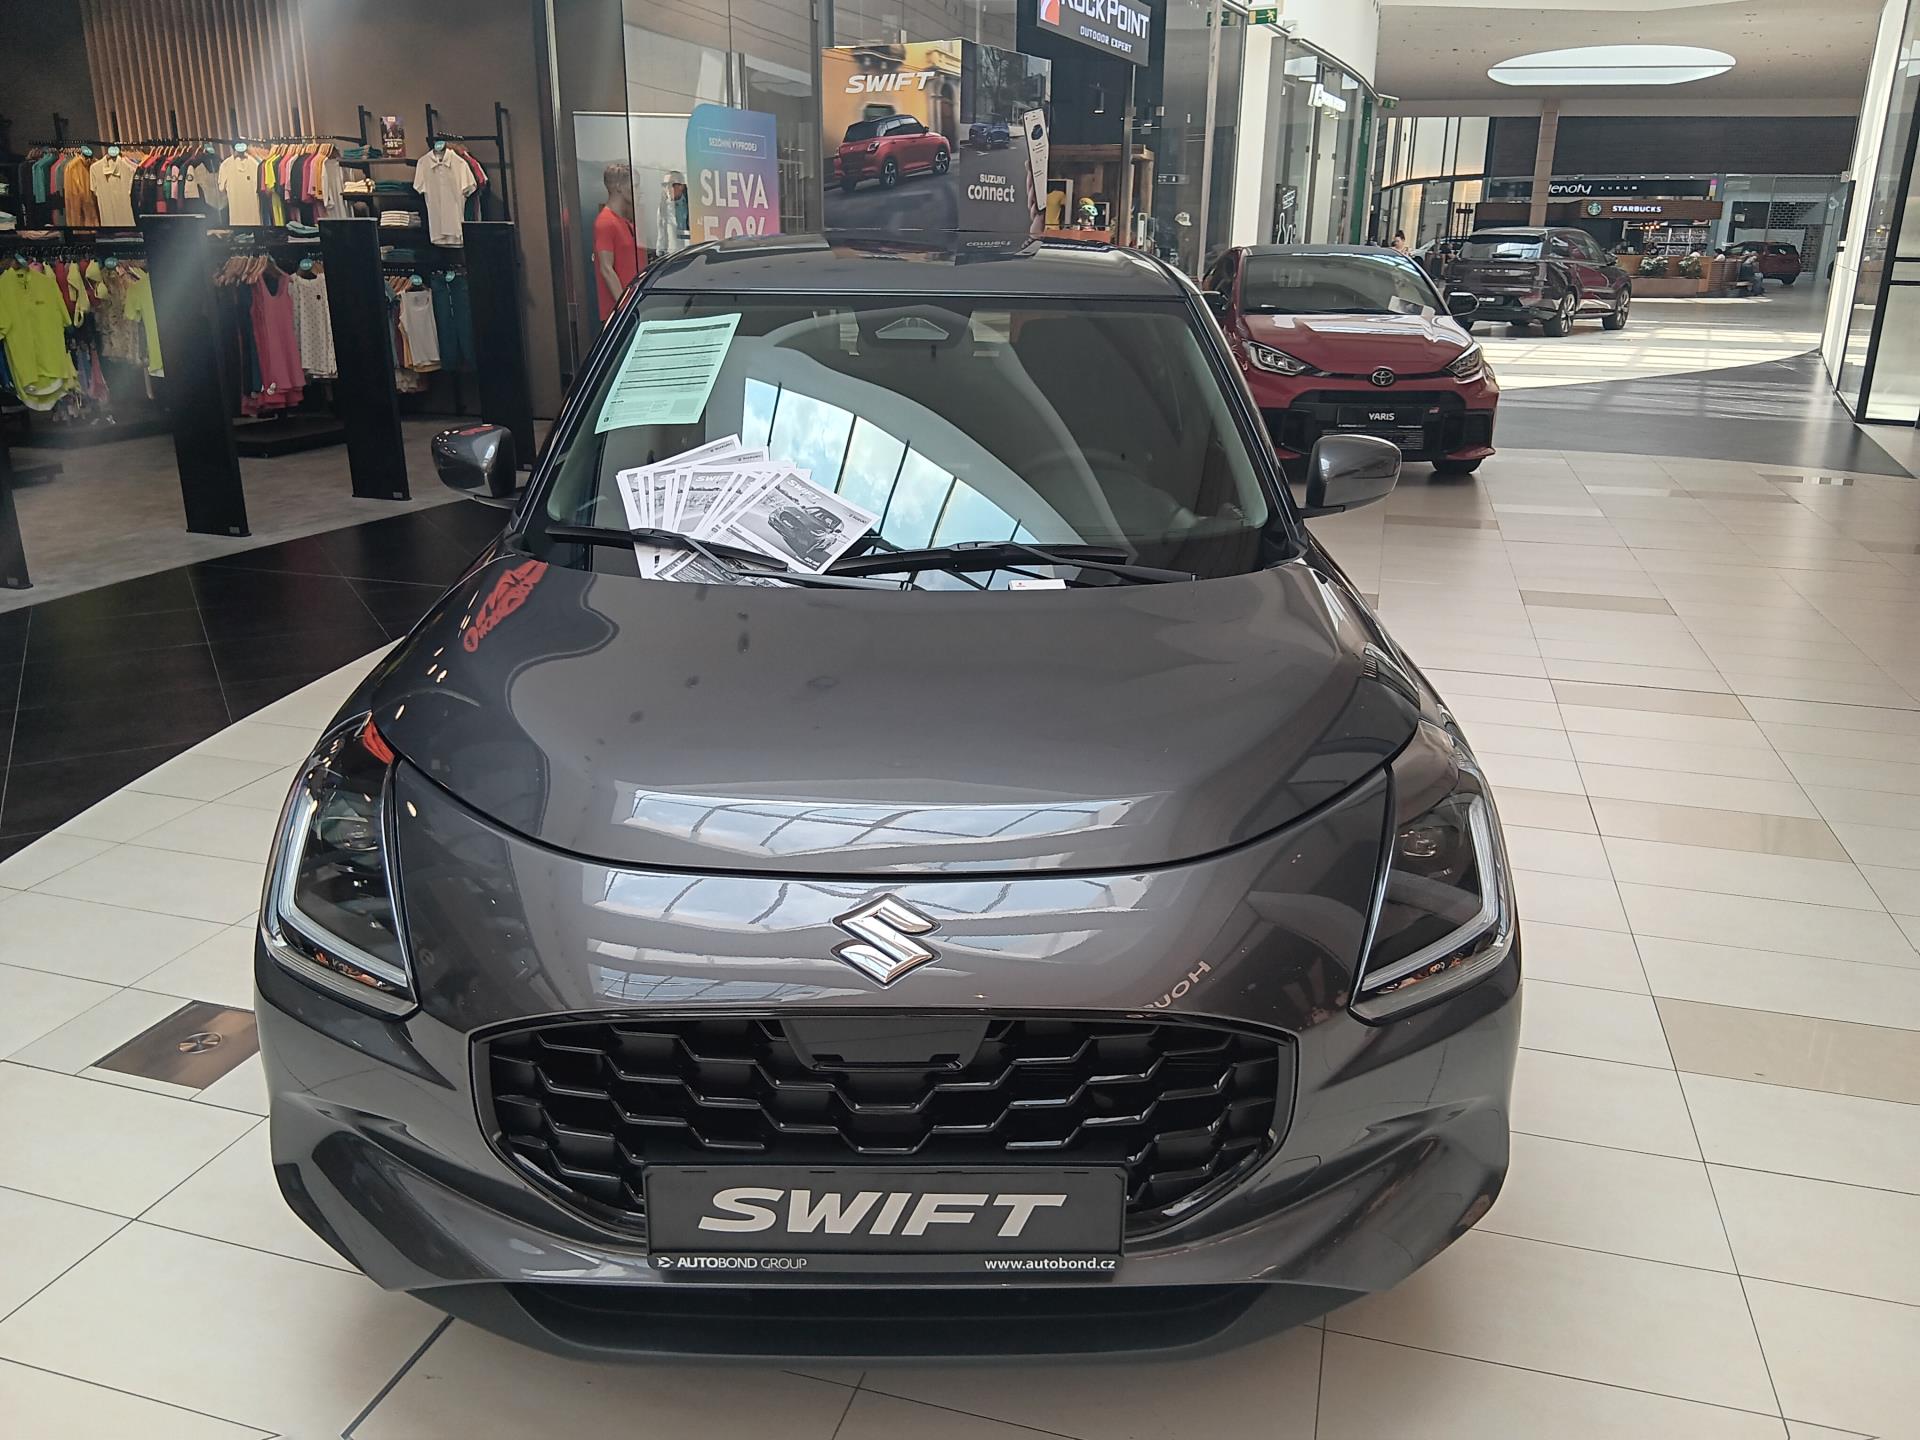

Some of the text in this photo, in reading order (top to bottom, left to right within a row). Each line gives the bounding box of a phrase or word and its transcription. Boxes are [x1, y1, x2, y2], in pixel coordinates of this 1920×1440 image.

[1079, 25, 1132, 53] OUTDOOR EXPERT
[845, 71, 935, 94] SWIFT
[979, 173, 1007, 184] SUZUKI
[699, 168, 769, 209] SLEVA
[967, 184, 1015, 203] connect
[1548, 183, 1592, 195] lenoty
[1612, 205, 1662, 213] STARBUCKS
[1368, 412, 1396, 421] YARIS
[786, 479, 822, 502] SWIFT
[697, 1186, 1067, 1238] SWIFT
[676, 1256, 807, 1270] AUTOBOND GROUP
[984, 1256, 1116, 1270] www.autobond.cz
